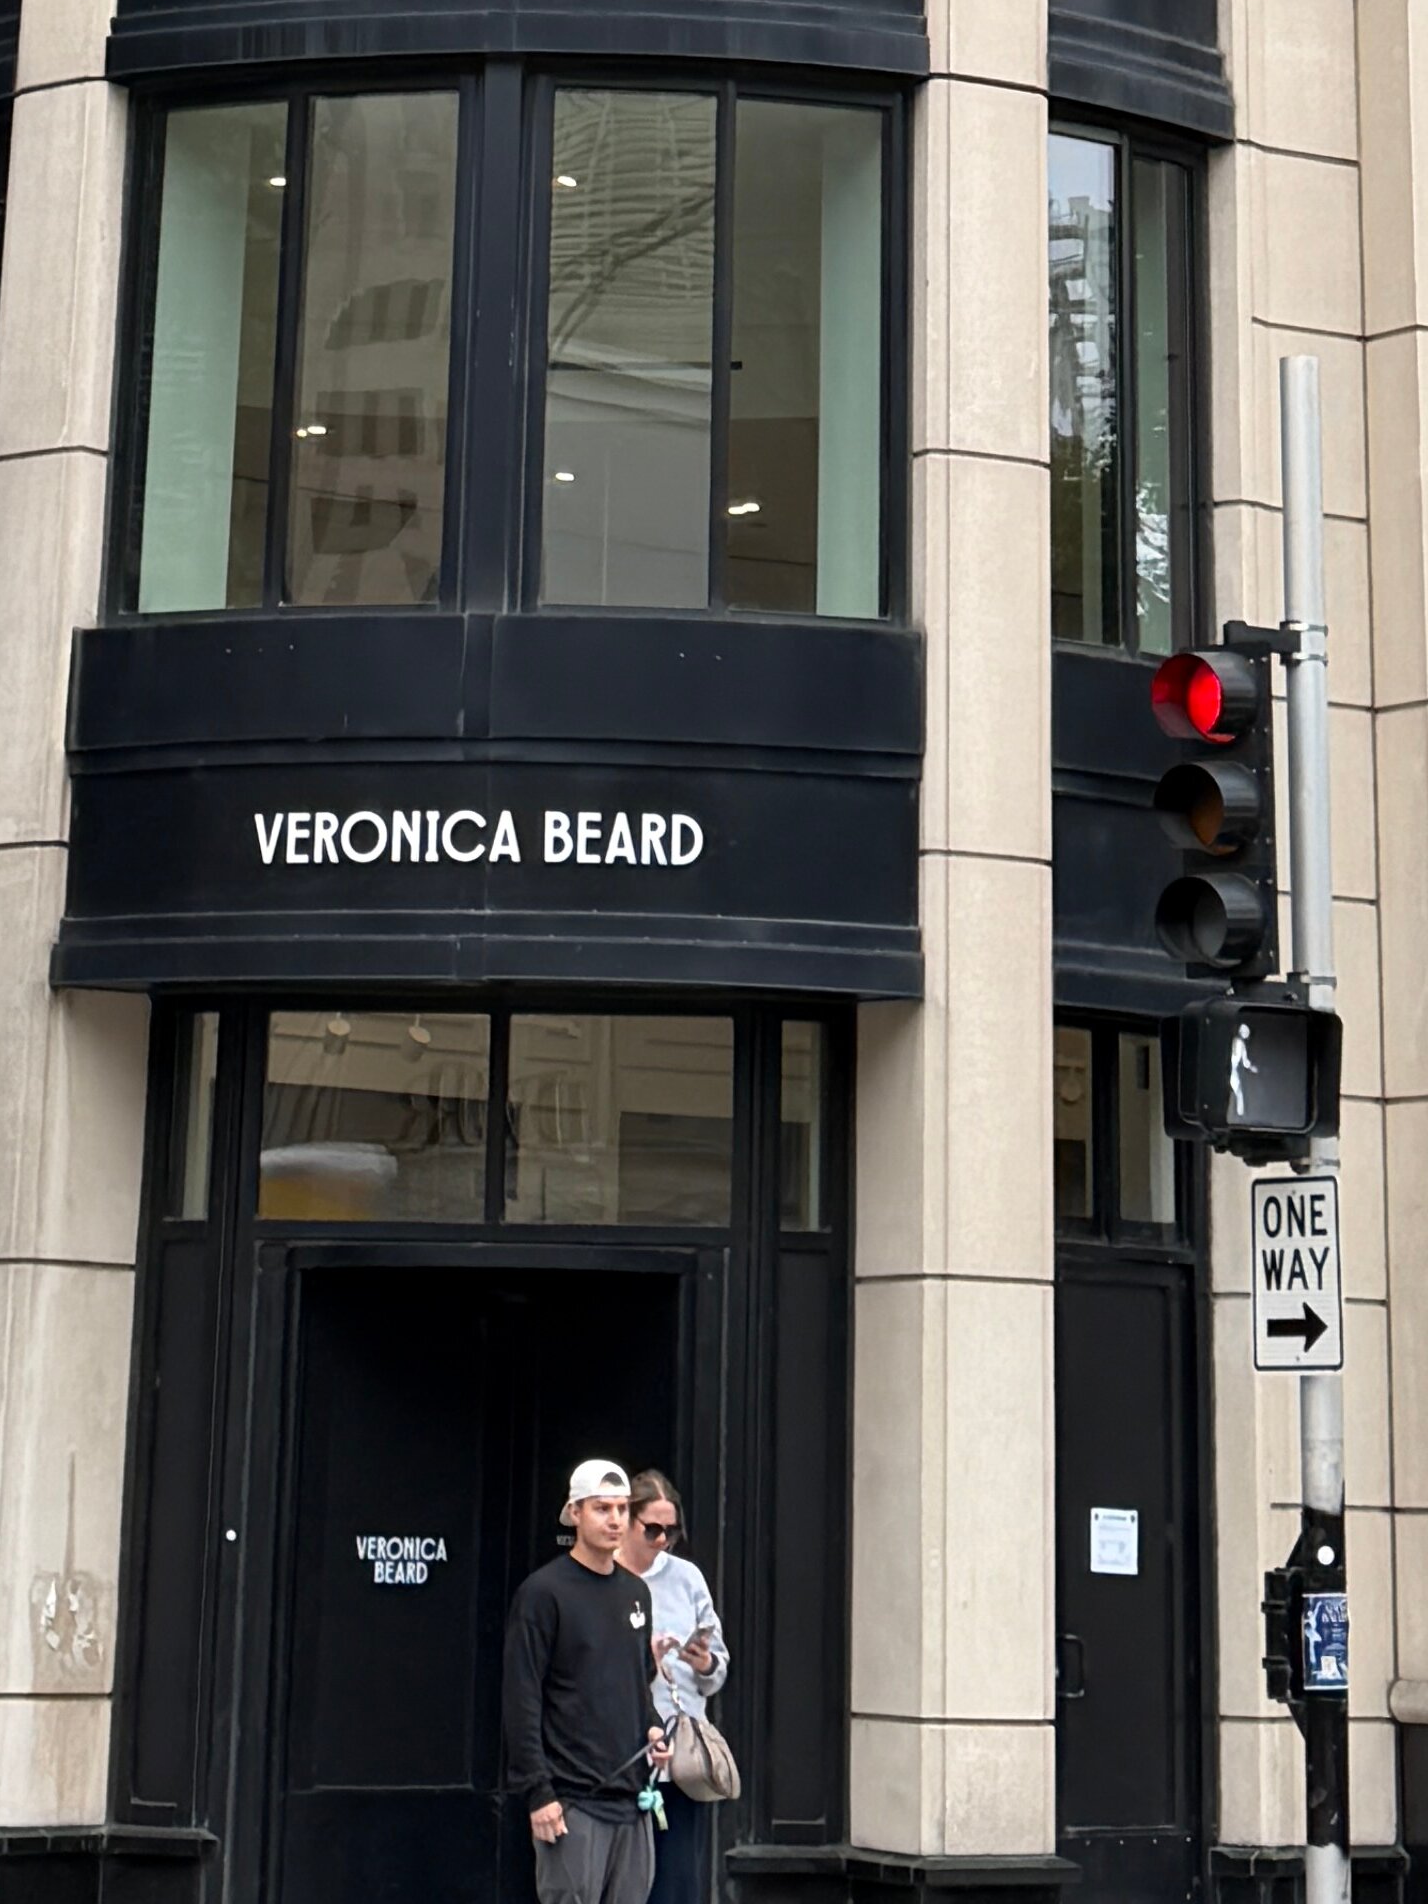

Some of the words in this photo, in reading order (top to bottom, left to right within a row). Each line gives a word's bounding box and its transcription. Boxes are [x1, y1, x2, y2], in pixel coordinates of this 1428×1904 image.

[254, 810, 521, 864] VERONICA
[543, 810, 704, 866] BEARD
[1263, 1194, 1328, 1238] ONE
[1262, 1246, 1330, 1291] WAY
[356, 1535, 448, 1562] VERONICA
[374, 1561, 428, 1584] BEARD
